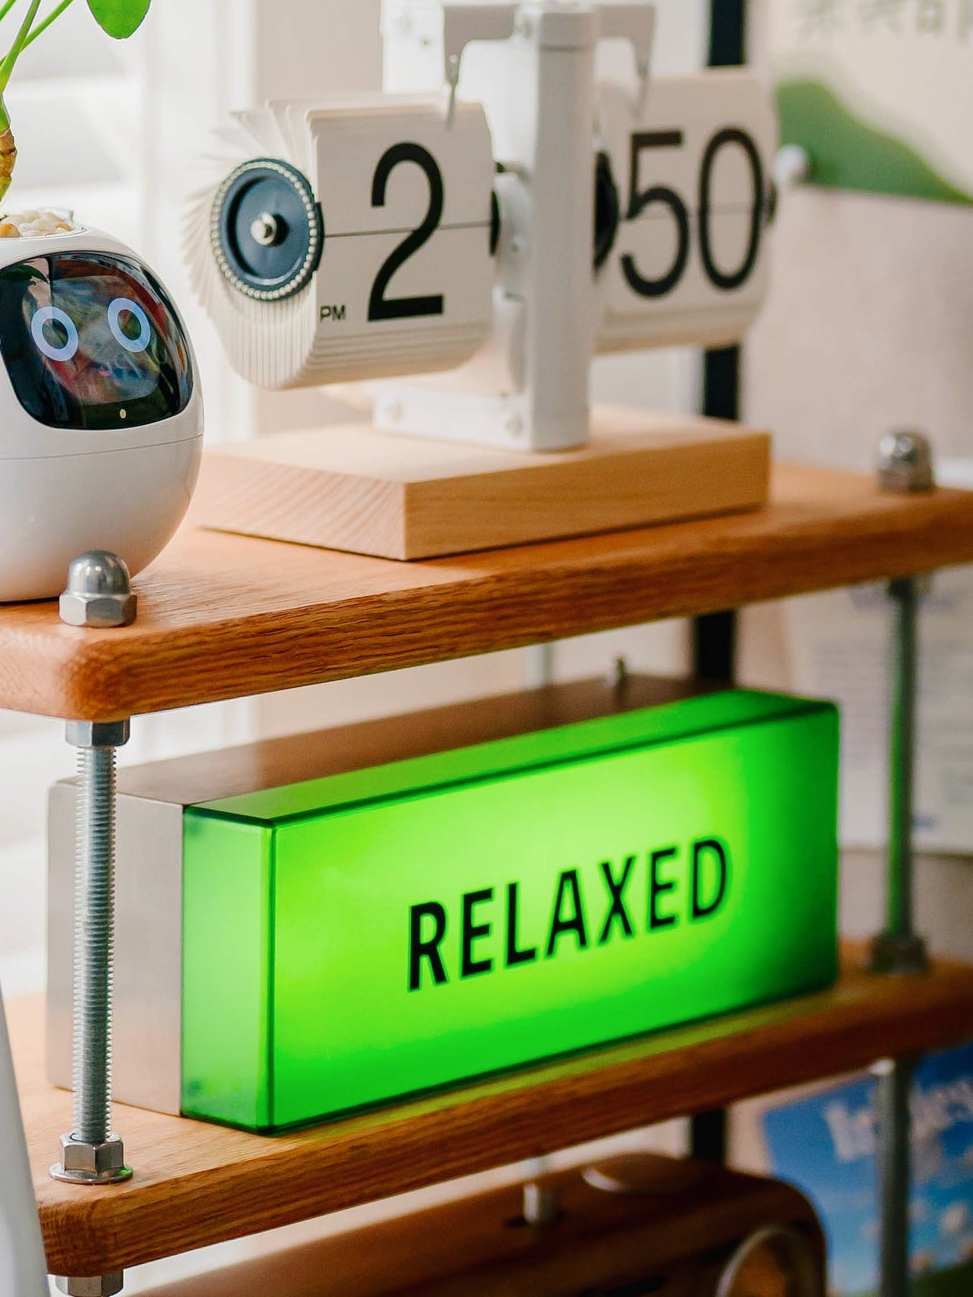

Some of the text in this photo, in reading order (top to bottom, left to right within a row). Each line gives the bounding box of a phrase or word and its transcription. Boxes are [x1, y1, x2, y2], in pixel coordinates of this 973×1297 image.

[366, 142, 445, 322] 2
[620, 126, 766, 299] 50
[319, 304, 347, 323] PM
[407, 836, 731, 992] RELAXED
